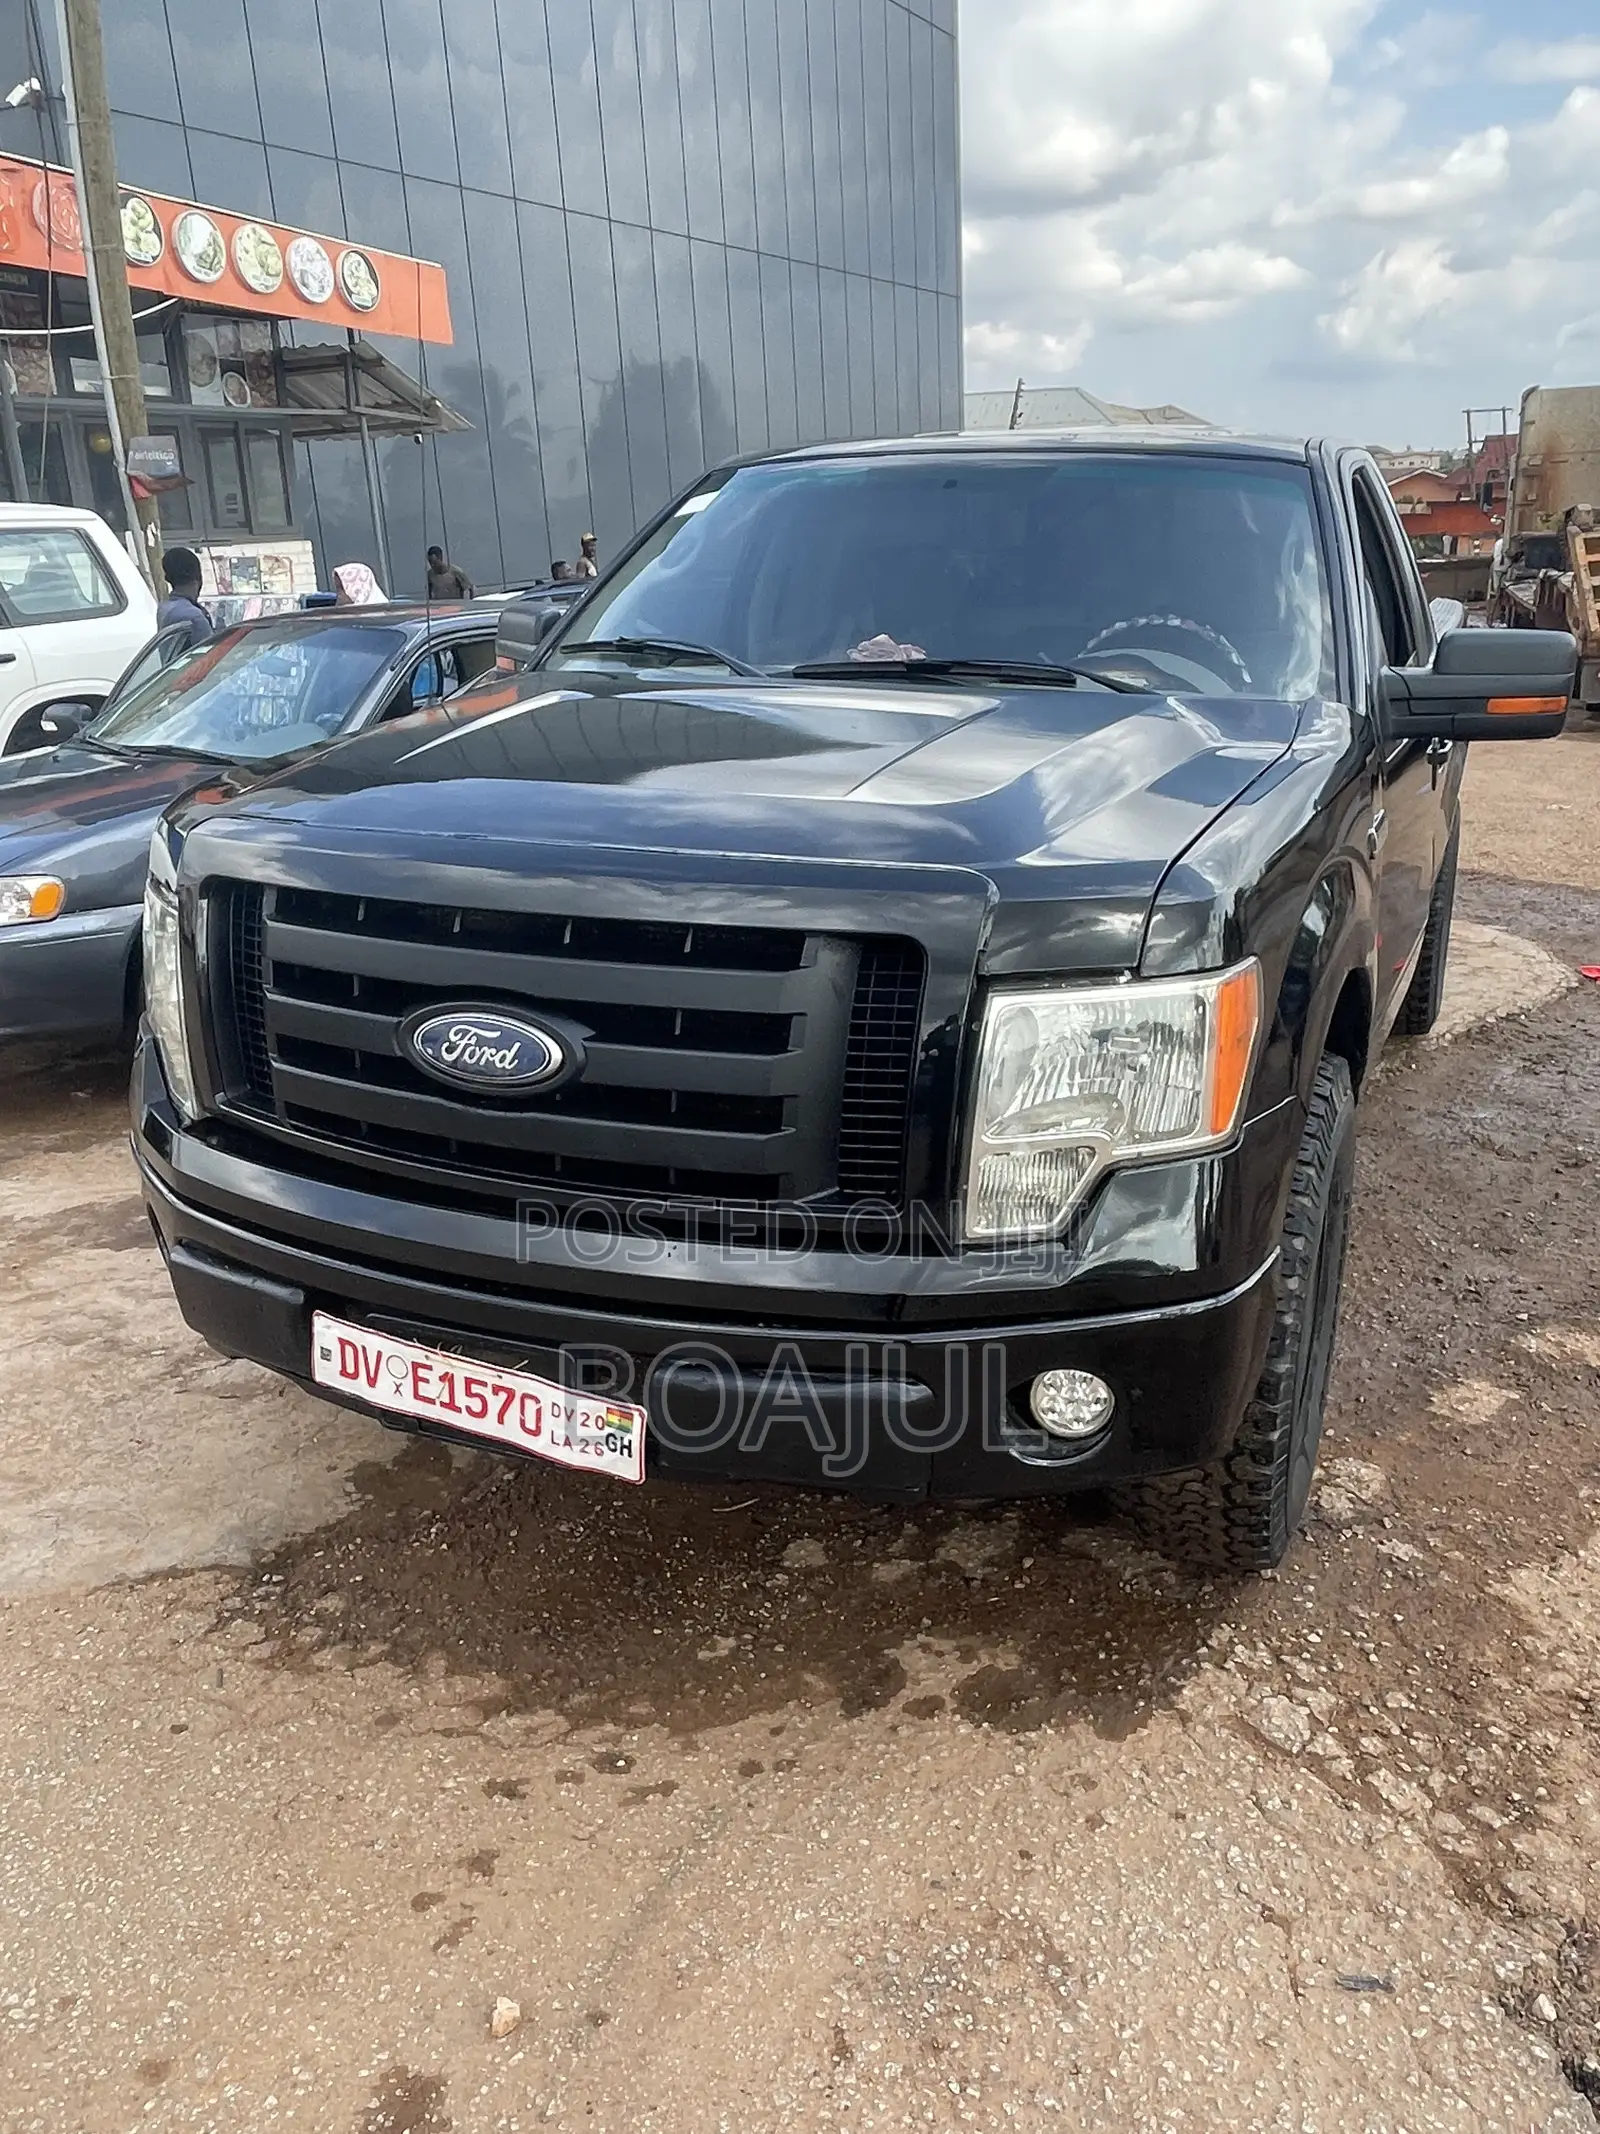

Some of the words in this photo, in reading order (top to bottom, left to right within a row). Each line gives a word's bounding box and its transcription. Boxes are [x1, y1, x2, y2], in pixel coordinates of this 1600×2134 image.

[441, 1024, 521, 1069] Ford
[337, 1336, 383, 1388] DV
[411, 1361, 541, 1436] E1570
[551, 1401, 575, 1422] DV
[580, 1411, 606, 1430] 20
[551, 1430, 574, 1451] LA
[579, 1439, 605, 1457] 26
[605, 1432, 632, 1458] GH
